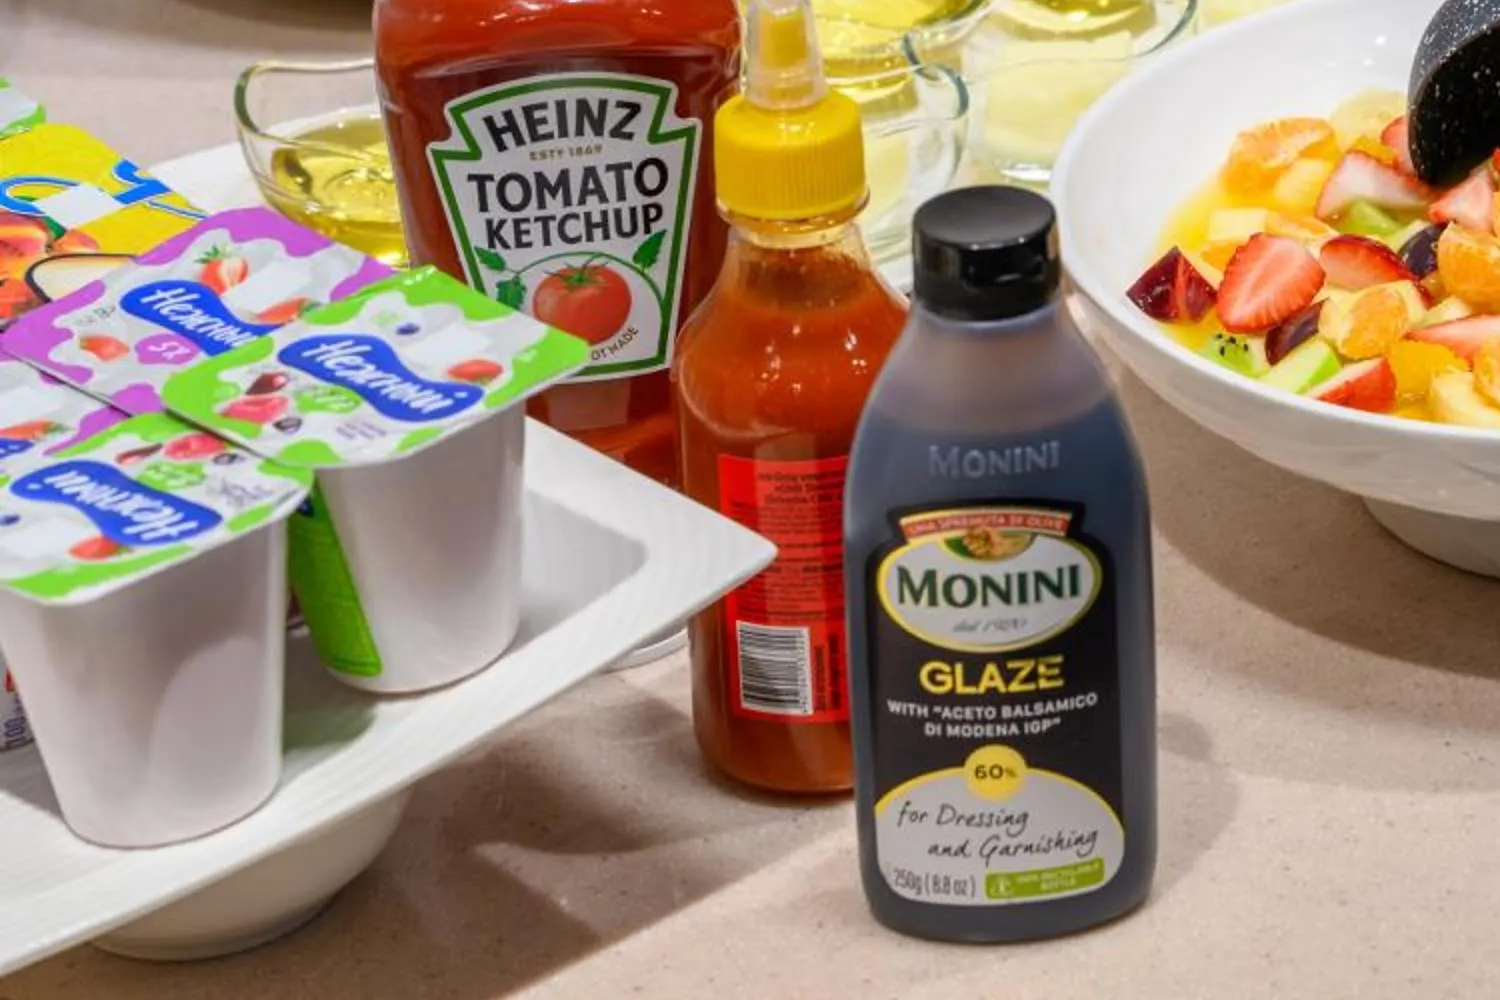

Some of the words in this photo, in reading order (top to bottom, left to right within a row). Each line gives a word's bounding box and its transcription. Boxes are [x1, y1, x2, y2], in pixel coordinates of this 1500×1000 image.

[483, 97, 642, 153] HEINZ
[467, 157, 669, 213] TOMATO
[485, 202, 663, 250] KETCHUP
[608, 327, 639, 355] MADE
[928, 439, 1060, 479] MONINI
[896, 563, 1080, 608] MONINI
[919, 654, 1065, 695] GLAZE
[886, 699, 929, 718] WITH
[1001, 692, 1099, 719] BALSAMICO
[924, 722, 942, 737] DI
[946, 722, 1020, 739] MODENA
[974, 763, 1018, 781] 60%
[897, 801, 929, 828] for
[936, 803, 1030, 838] Dressing
[927, 839, 973, 858] and
[978, 829, 1098, 869] Garnishing
